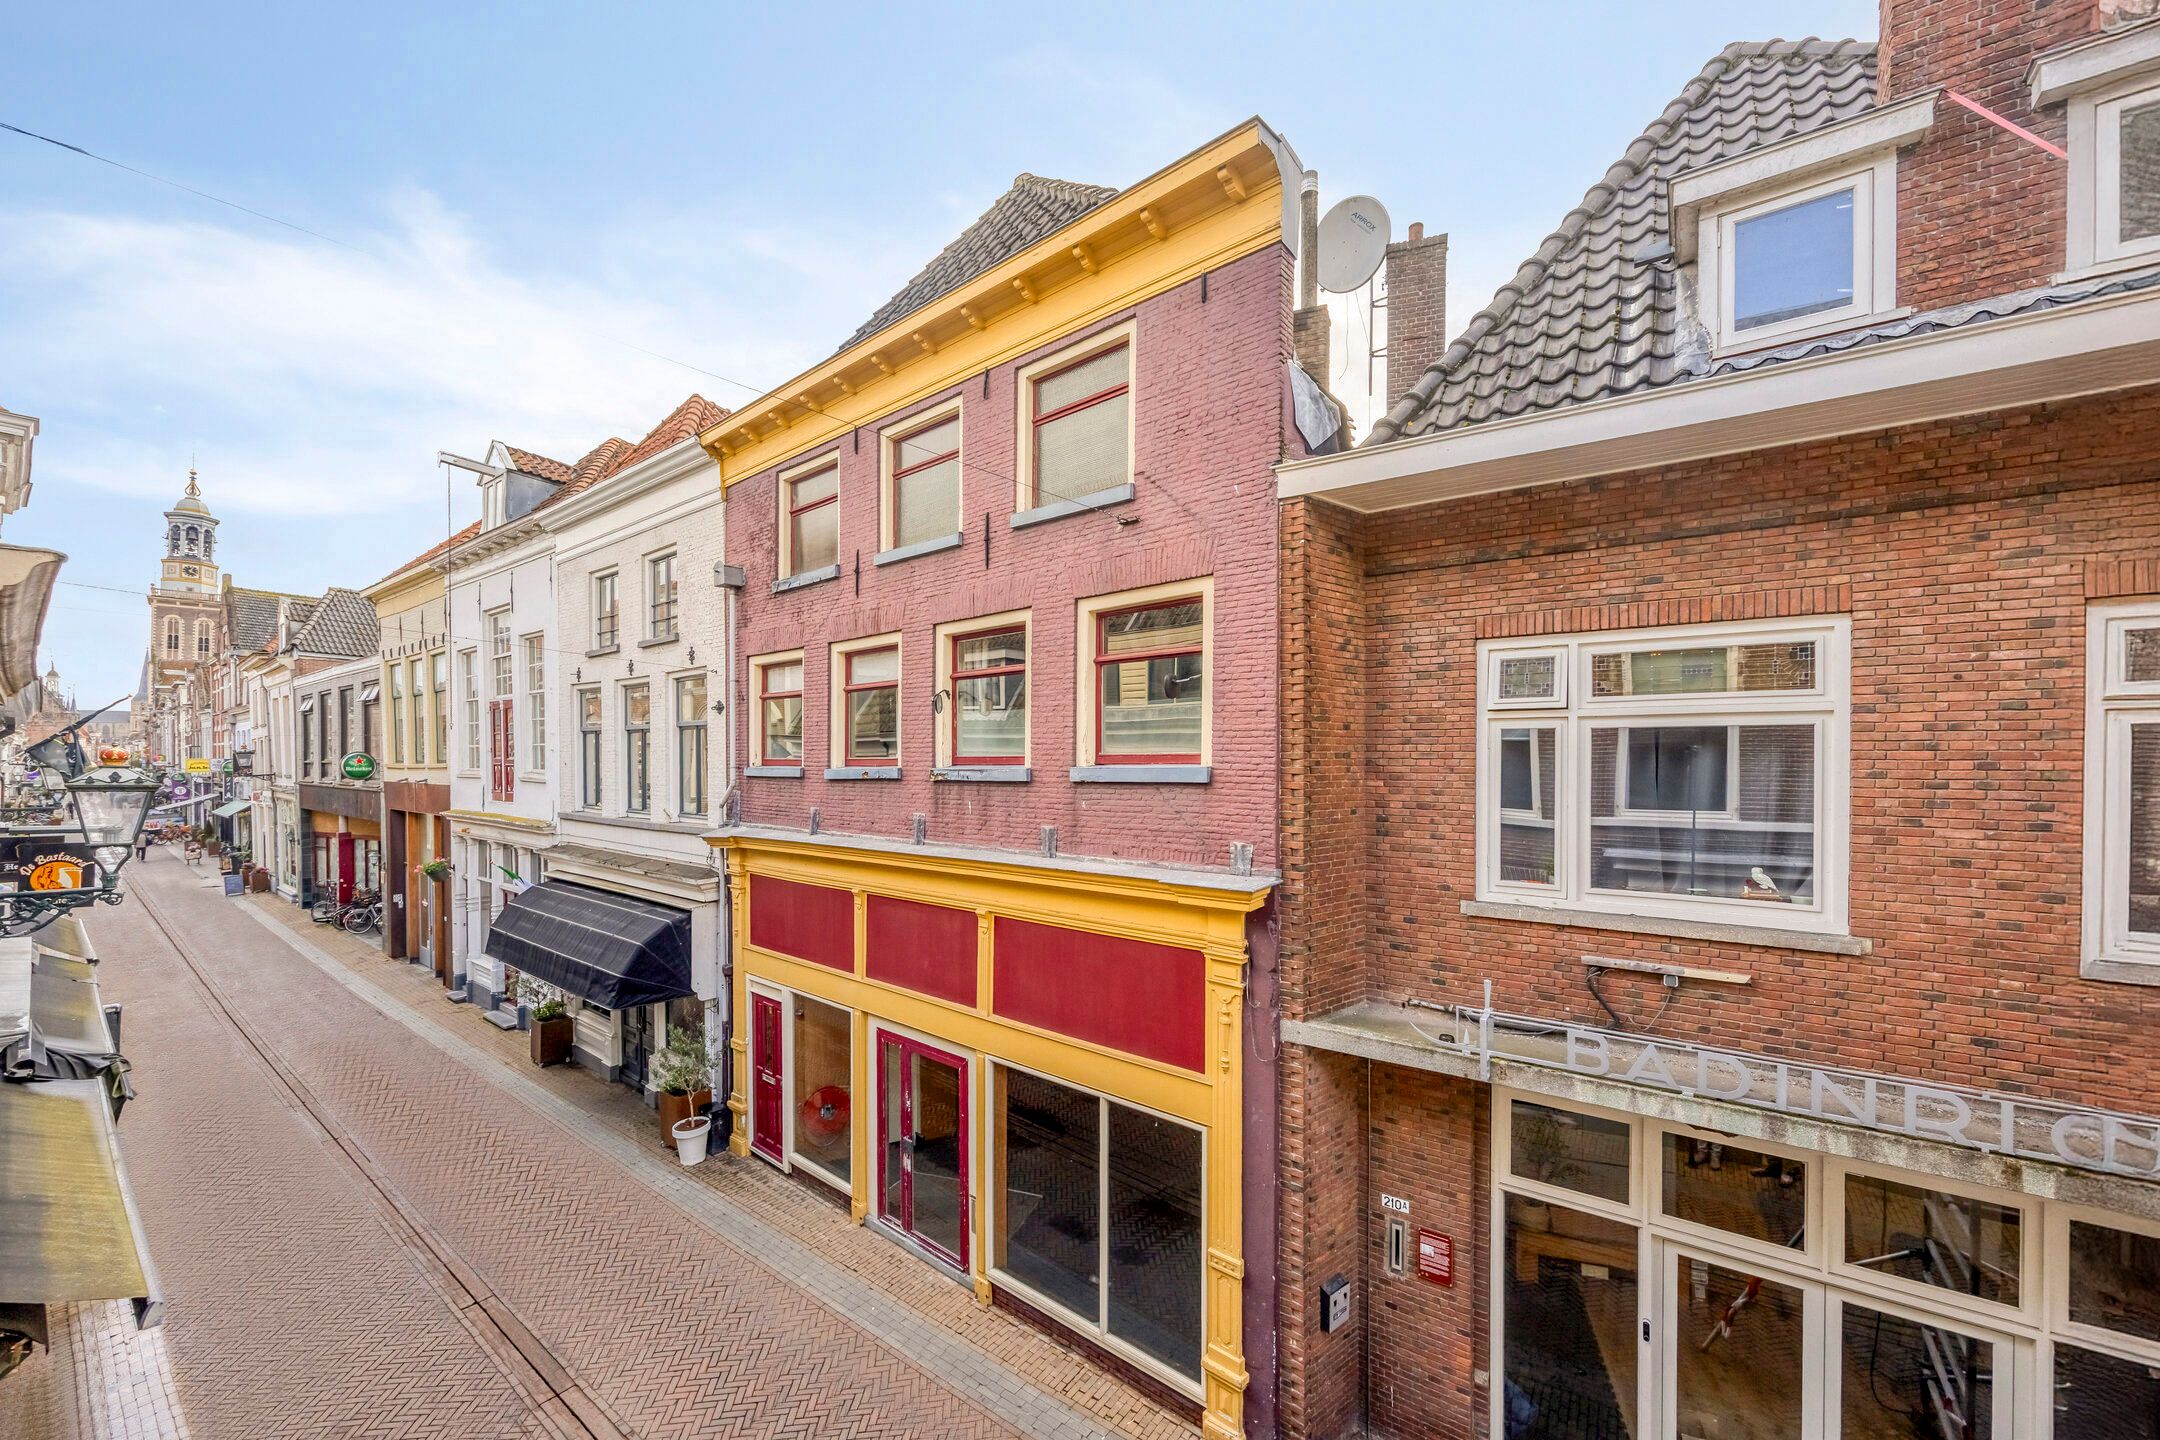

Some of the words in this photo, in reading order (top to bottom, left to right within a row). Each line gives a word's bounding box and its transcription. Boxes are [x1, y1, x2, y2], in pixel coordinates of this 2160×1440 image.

[1351, 212, 1376, 232] ARROX
[20, 863, 36, 876] De
[35, 852, 95, 868] Bastaard
